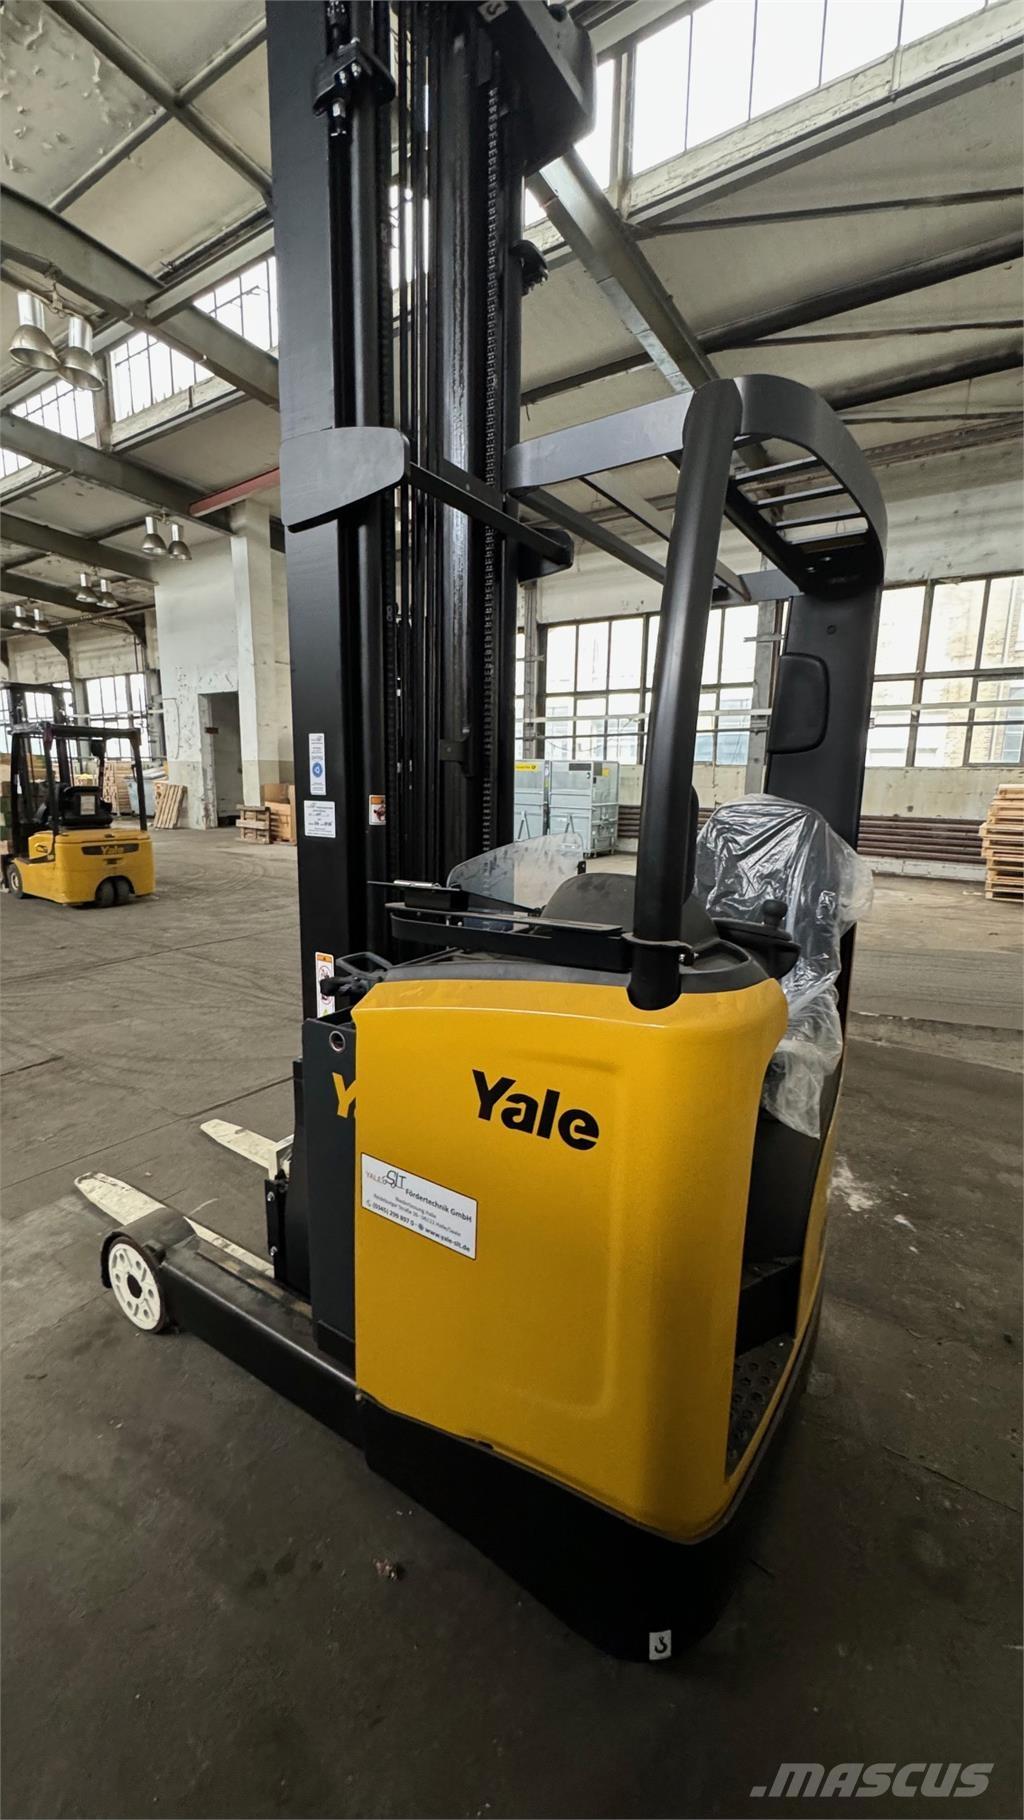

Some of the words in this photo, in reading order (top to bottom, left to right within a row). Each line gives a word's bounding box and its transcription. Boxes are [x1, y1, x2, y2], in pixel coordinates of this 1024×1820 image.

[472, 1069, 599, 1150] Yale
[405, 1188, 449, 1213] Fördertechnik
[450, 1208, 472, 1223] GmbH
